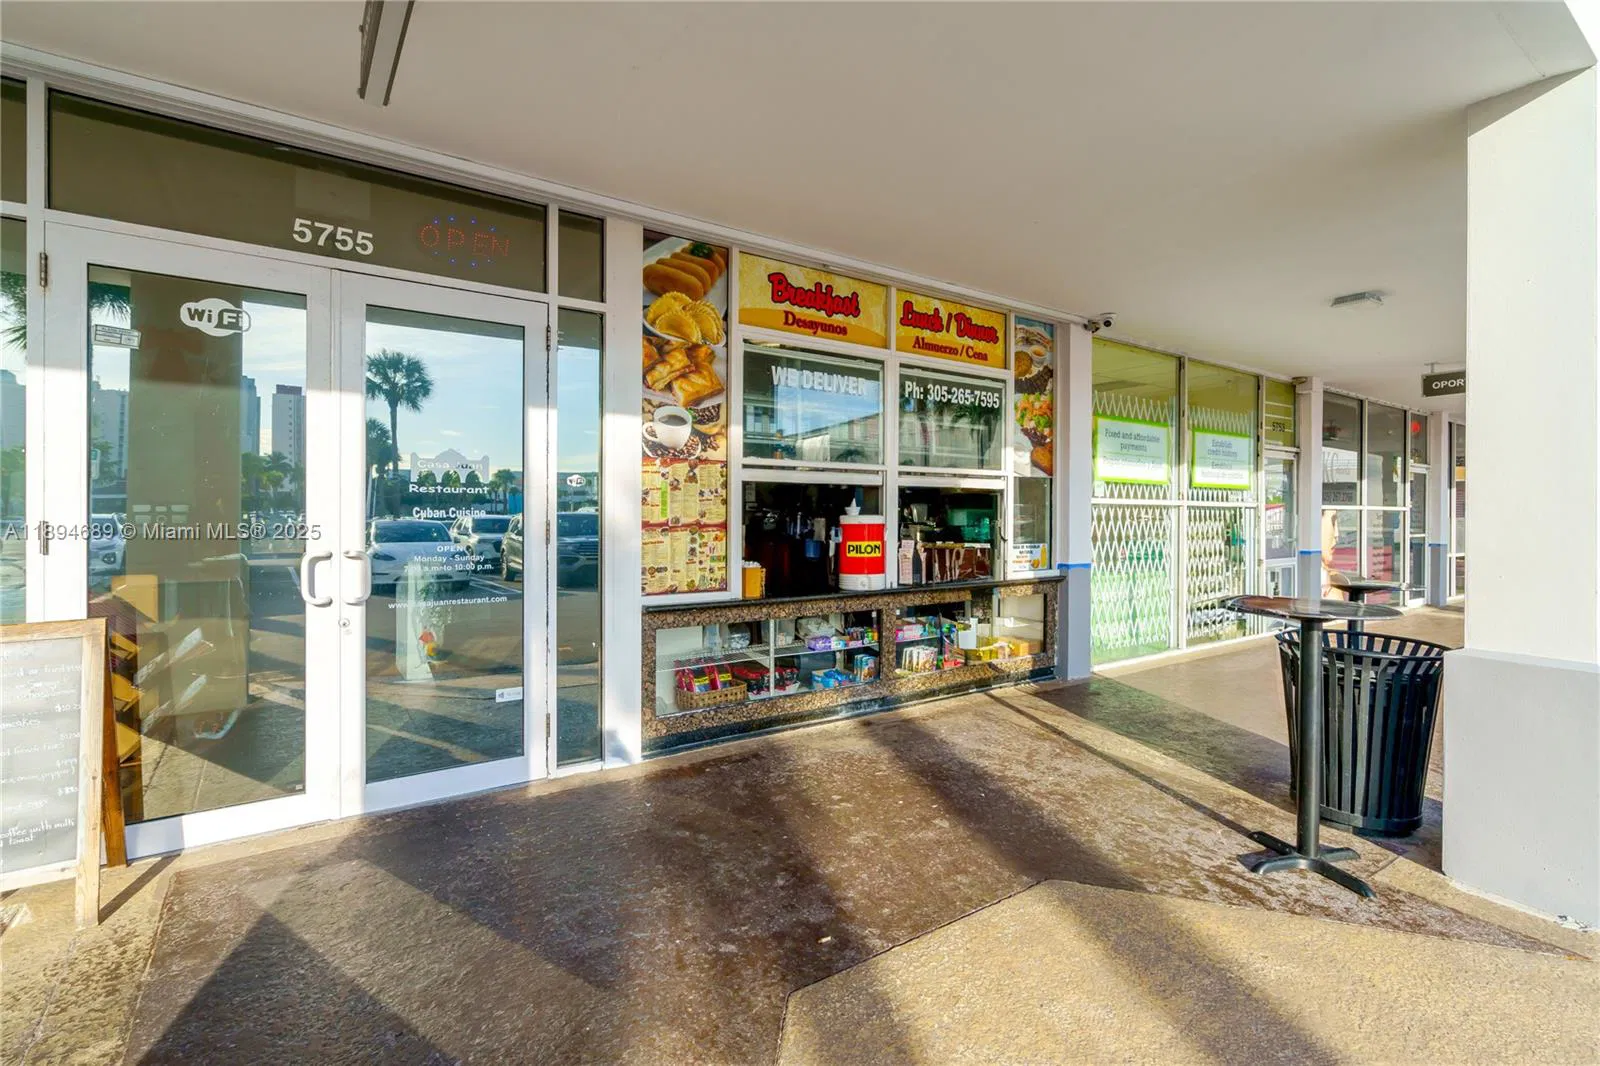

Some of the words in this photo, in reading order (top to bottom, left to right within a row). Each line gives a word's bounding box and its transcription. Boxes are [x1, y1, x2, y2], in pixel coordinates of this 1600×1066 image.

[292, 217, 374, 256] 5755
[420, 224, 510, 257] OPEN
[768, 272, 861, 318] Breakfast
[783, 310, 848, 336] Desayunos
[900, 300, 944, 333] Lunch
[946, 312, 953, 333] /
[954, 312, 999, 345] Dinner
[912, 335, 959, 356] Almuerzo
[966, 345, 989, 361] Cena
[771, 365, 800, 387] WE
[802, 369, 868, 396] DELIVER
[1432, 377, 1466, 390] OPOR
[905, 381, 924, 400] Ph:
[927, 383, 1000, 409] 305-265-7595
[1104, 428, 1121, 439] Fixed
[1122, 431, 1133, 441] and
[1133, 432, 1161, 444] affordable
[416, 460, 450, 469] Casa
[408, 483, 490, 494] Restaurant
[412, 506, 446, 519] Cuban
[448, 506, 487, 519] Cuisine
[414, 555, 447, 563] Monday
[454, 554, 485, 563] Sunday
[847, 543, 881, 555] PILON
[454, 563, 475, 571] 10:00
[477, 564, 494, 572] p.m.
